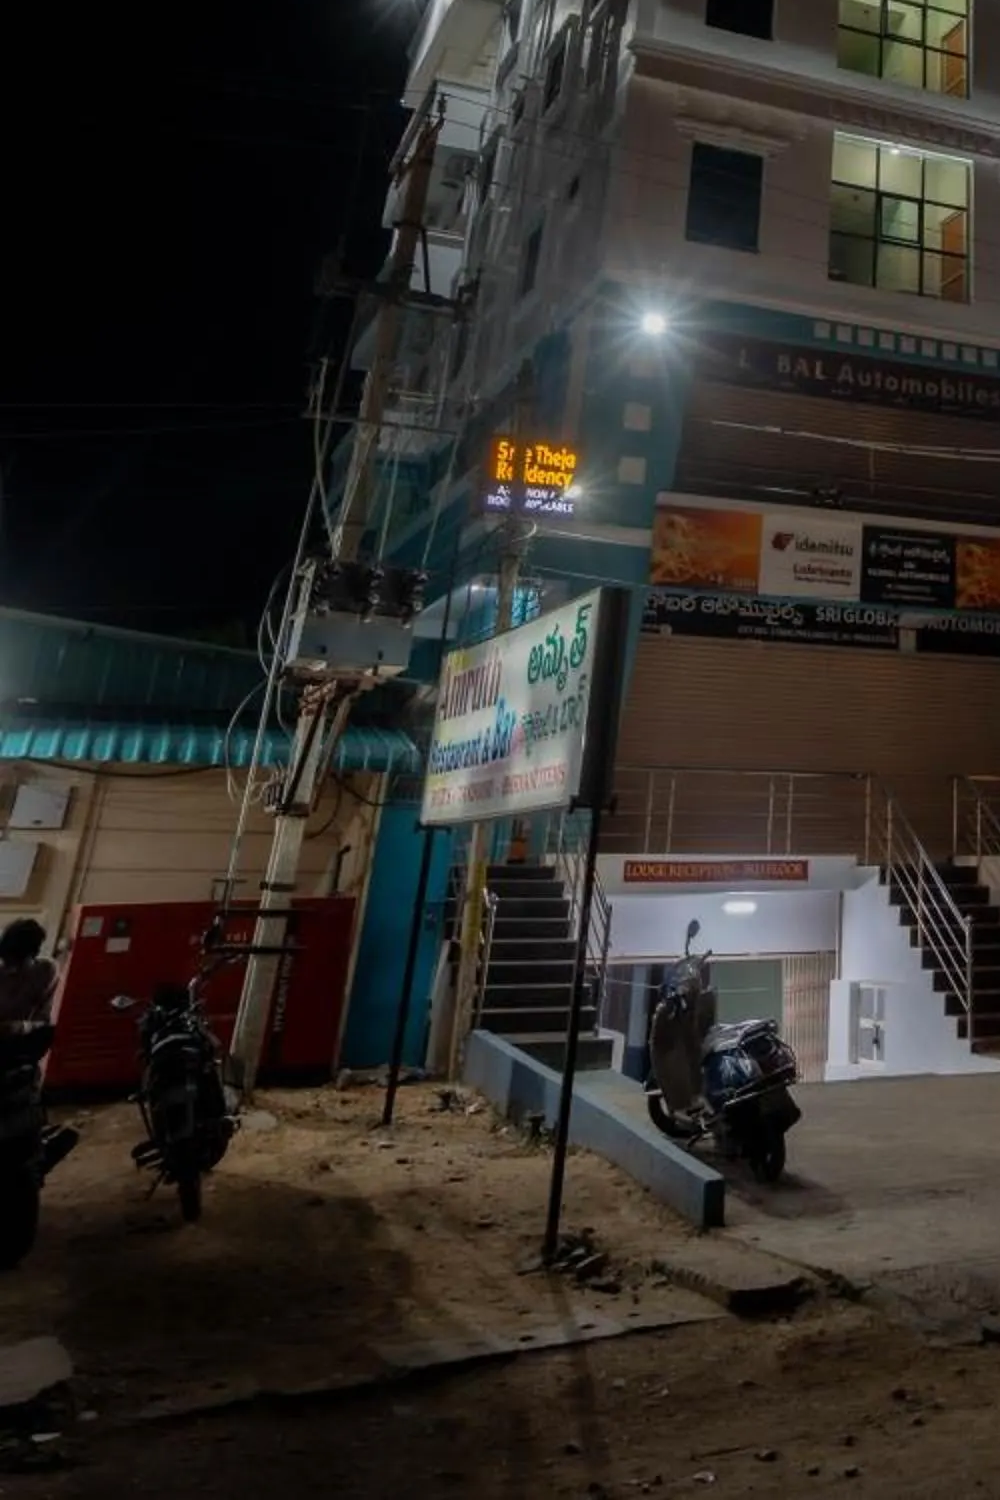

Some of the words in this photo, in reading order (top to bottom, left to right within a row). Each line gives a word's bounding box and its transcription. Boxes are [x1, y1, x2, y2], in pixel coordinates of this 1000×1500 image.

[836, 363, 1000, 406] Automobiles
[795, 532, 854, 557] idemitsu
[815, 605, 842, 624] SRI
[843, 608, 900, 629] GLOBA
